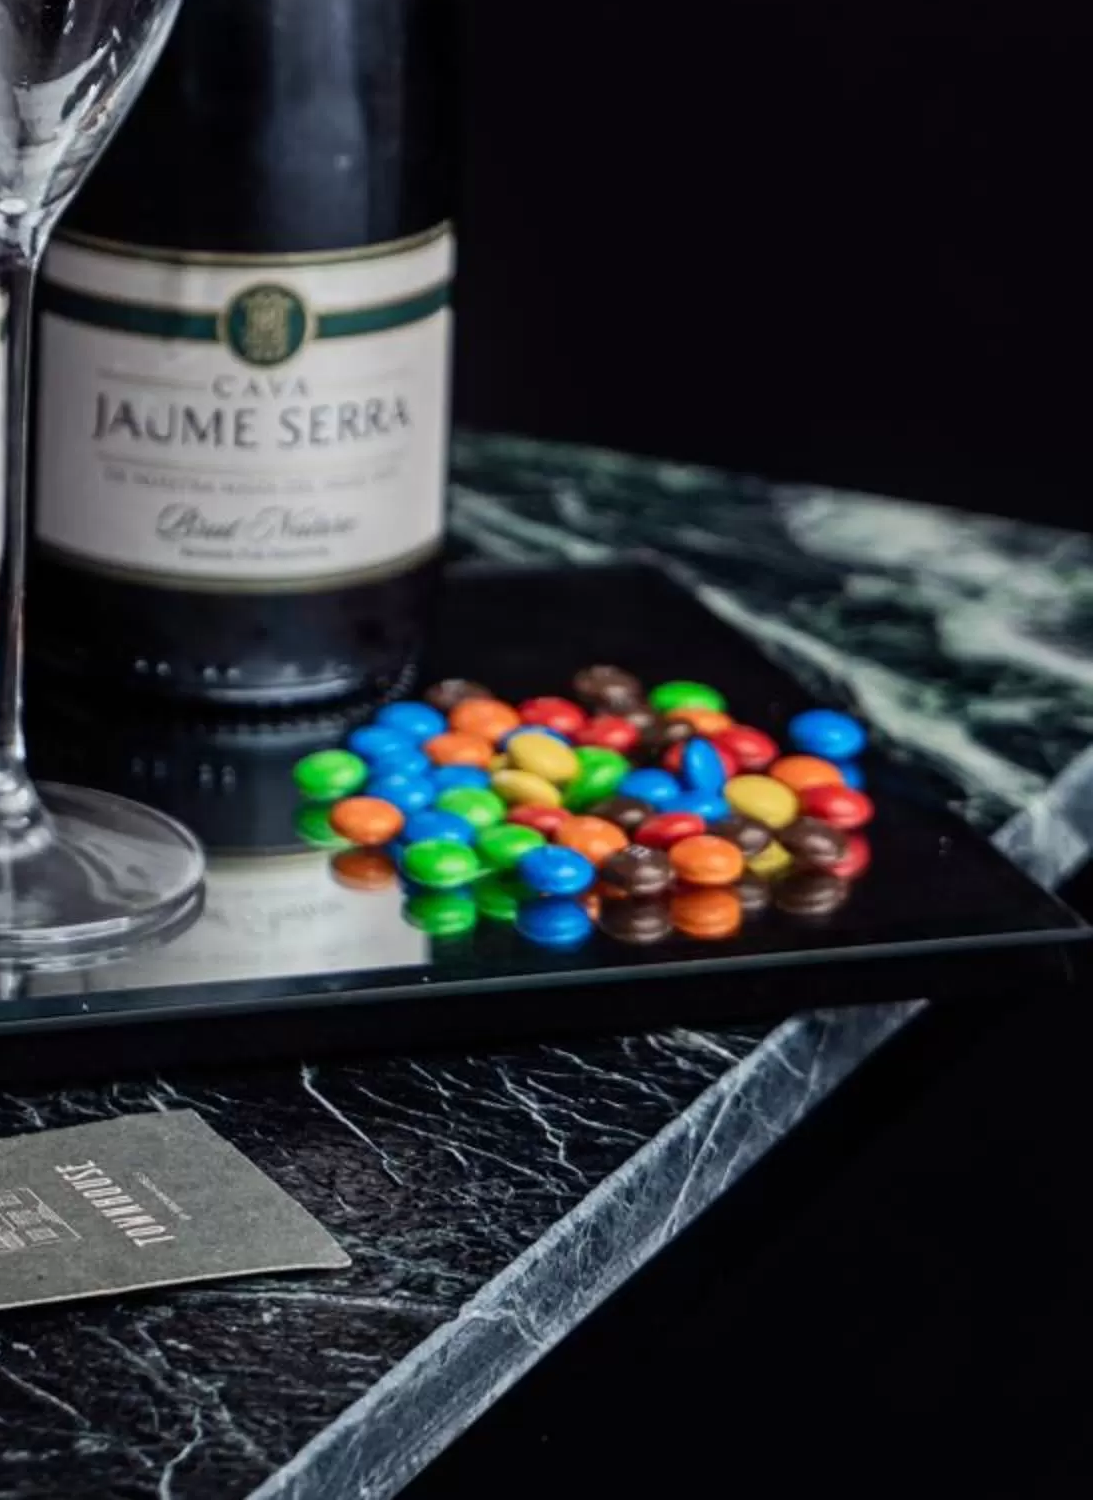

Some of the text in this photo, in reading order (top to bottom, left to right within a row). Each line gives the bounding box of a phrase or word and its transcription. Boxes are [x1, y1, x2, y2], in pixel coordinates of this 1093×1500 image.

[211, 374, 311, 399] CAVA
[92, 393, 411, 449] JAUME SERRA
